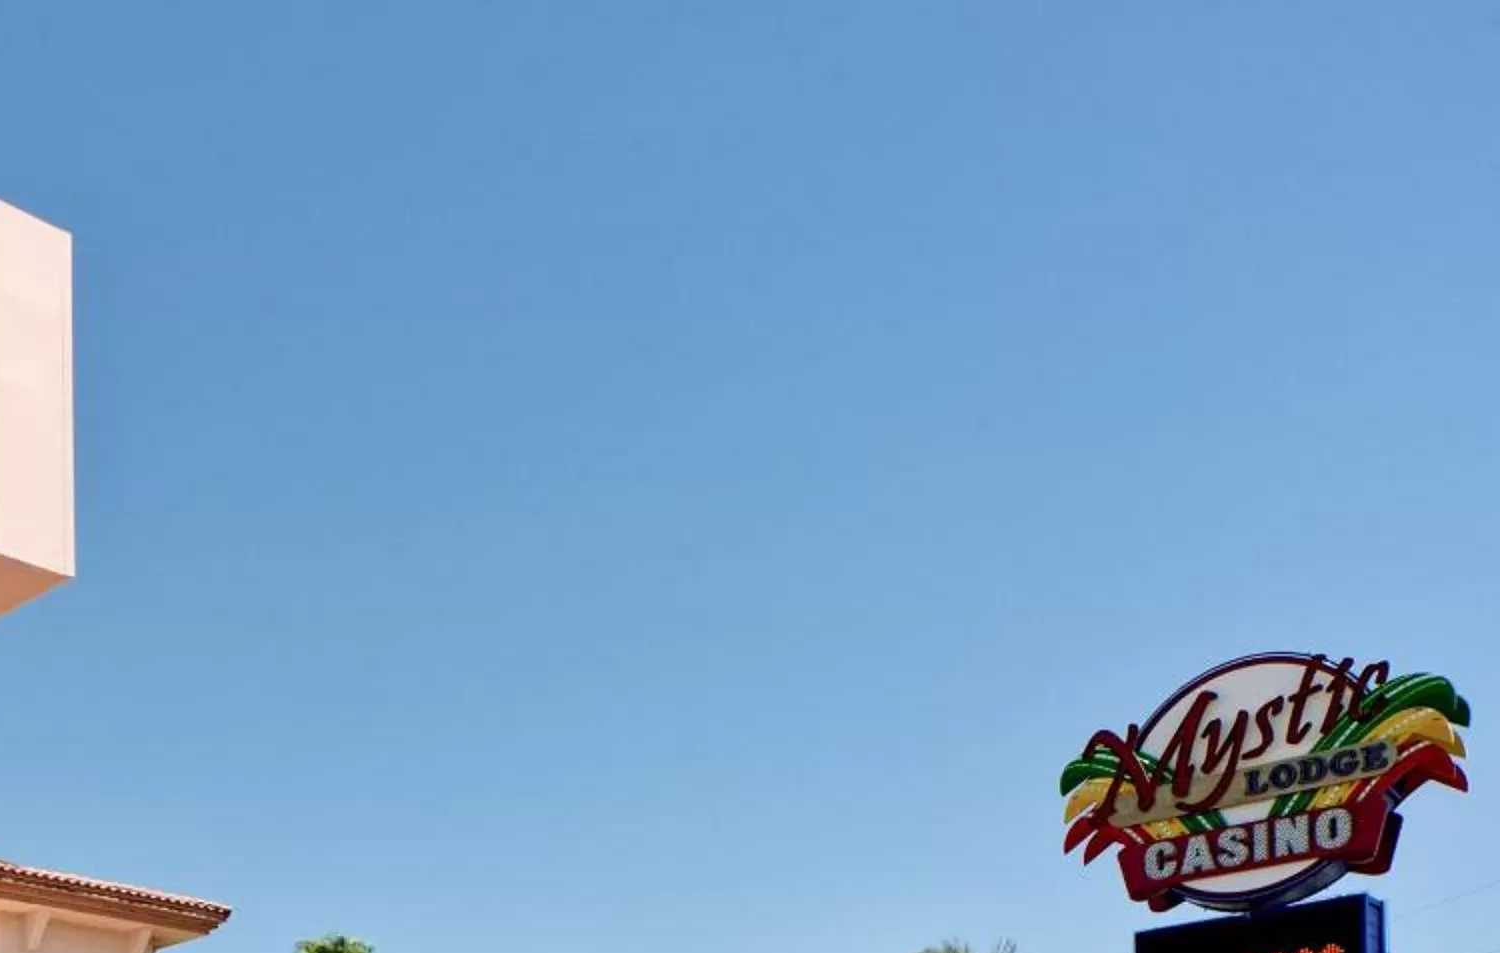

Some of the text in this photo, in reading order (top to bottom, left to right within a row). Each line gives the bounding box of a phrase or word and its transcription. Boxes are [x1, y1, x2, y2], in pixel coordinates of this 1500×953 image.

[1082, 653, 1390, 826] Mystic
[1244, 741, 1389, 796] LODGE
[1143, 808, 1353, 881] CASINO
